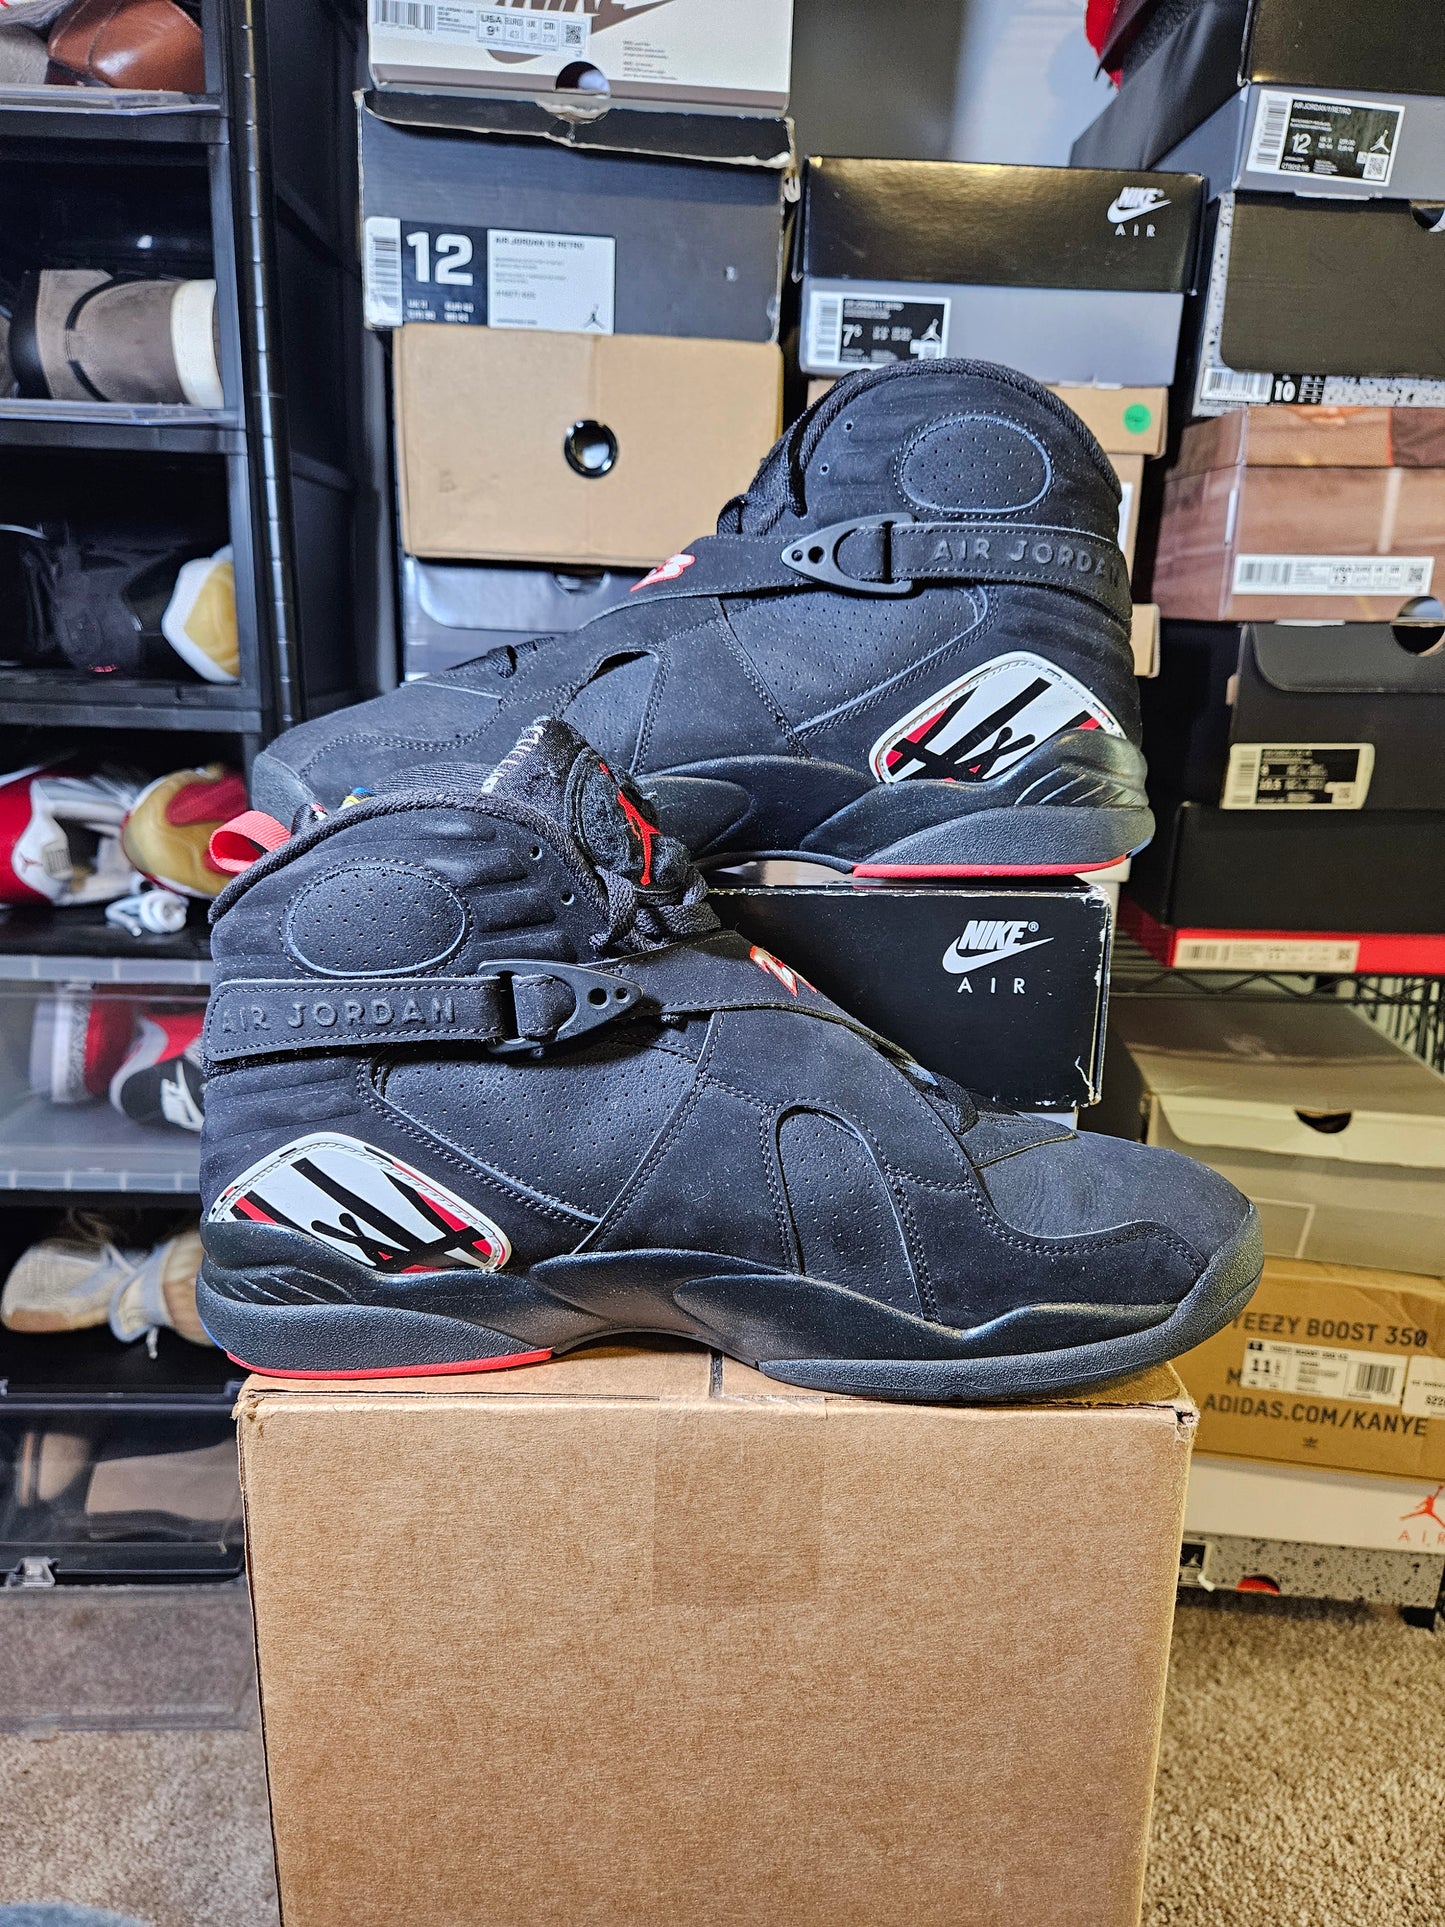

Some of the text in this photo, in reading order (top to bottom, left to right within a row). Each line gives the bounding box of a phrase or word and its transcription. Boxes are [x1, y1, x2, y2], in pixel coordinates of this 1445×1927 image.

[1292, 132, 1312, 155] 12
[1115, 223, 1156, 237] AIR
[406, 231, 474, 286] 12
[1274, 380, 1296, 402] 10
[933, 538, 991, 562] AIR
[957, 920, 1029, 950] NIKE
[957, 976, 1026, 994] AIR
[222, 997, 456, 1034] AIR JORDAN
[1232, 1312, 1429, 1348] YEEZY BOOST 350
[1203, 1392, 1429, 1437] ADIDAS.COM/KANYE
[1397, 1529, 1445, 1545] AIR
